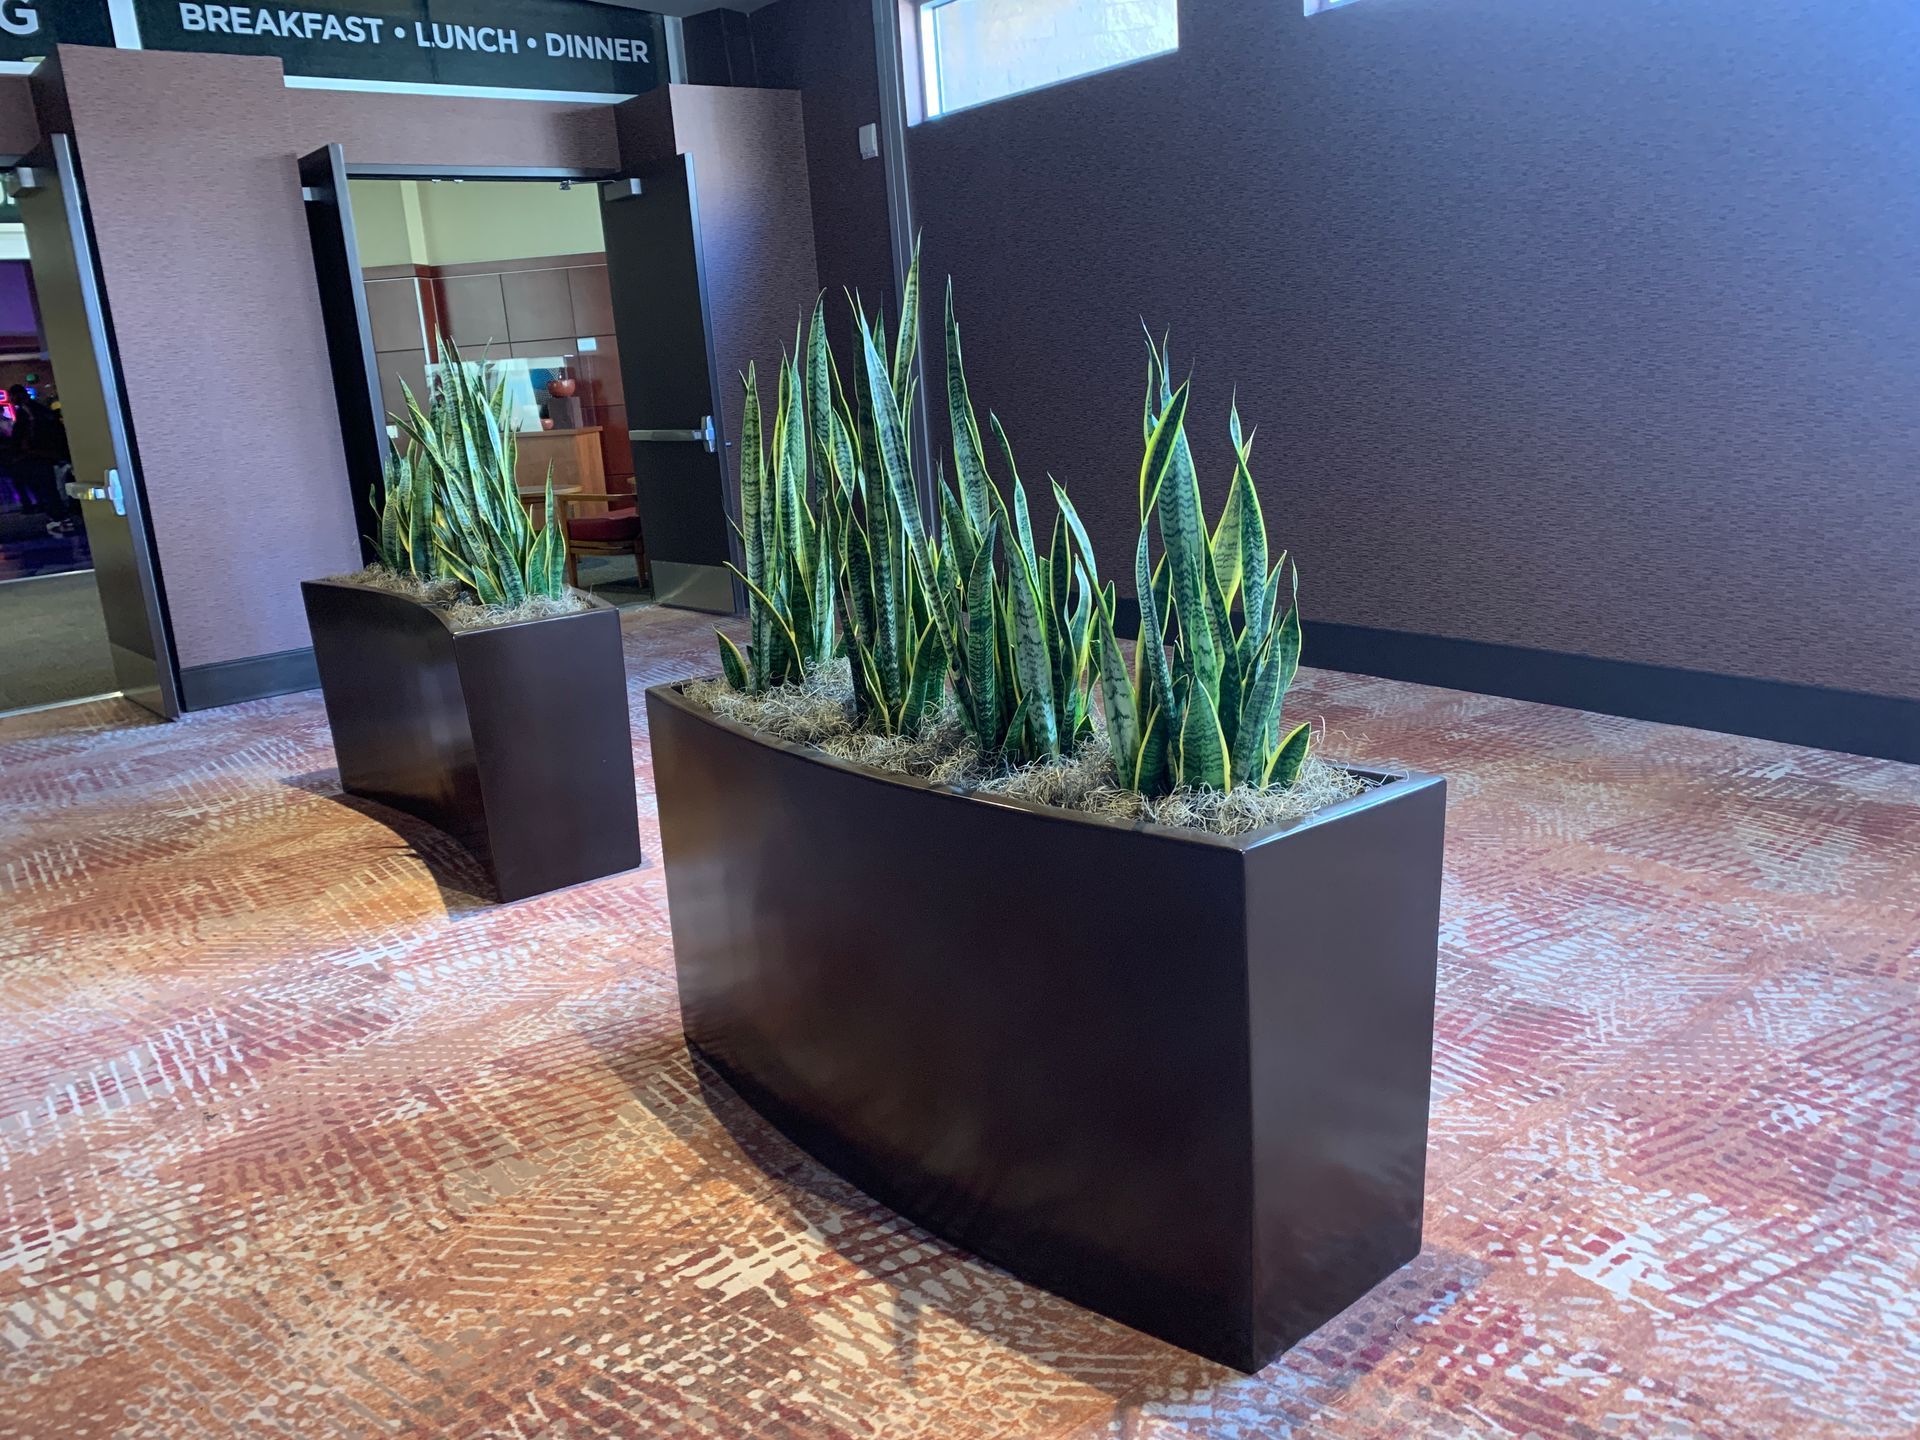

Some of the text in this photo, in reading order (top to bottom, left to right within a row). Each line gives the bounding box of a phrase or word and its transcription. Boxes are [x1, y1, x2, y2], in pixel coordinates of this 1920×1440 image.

[0, 0, 39, 35] G
[179, 2, 649, 64] BREAKFAST LUNCH DINNER
